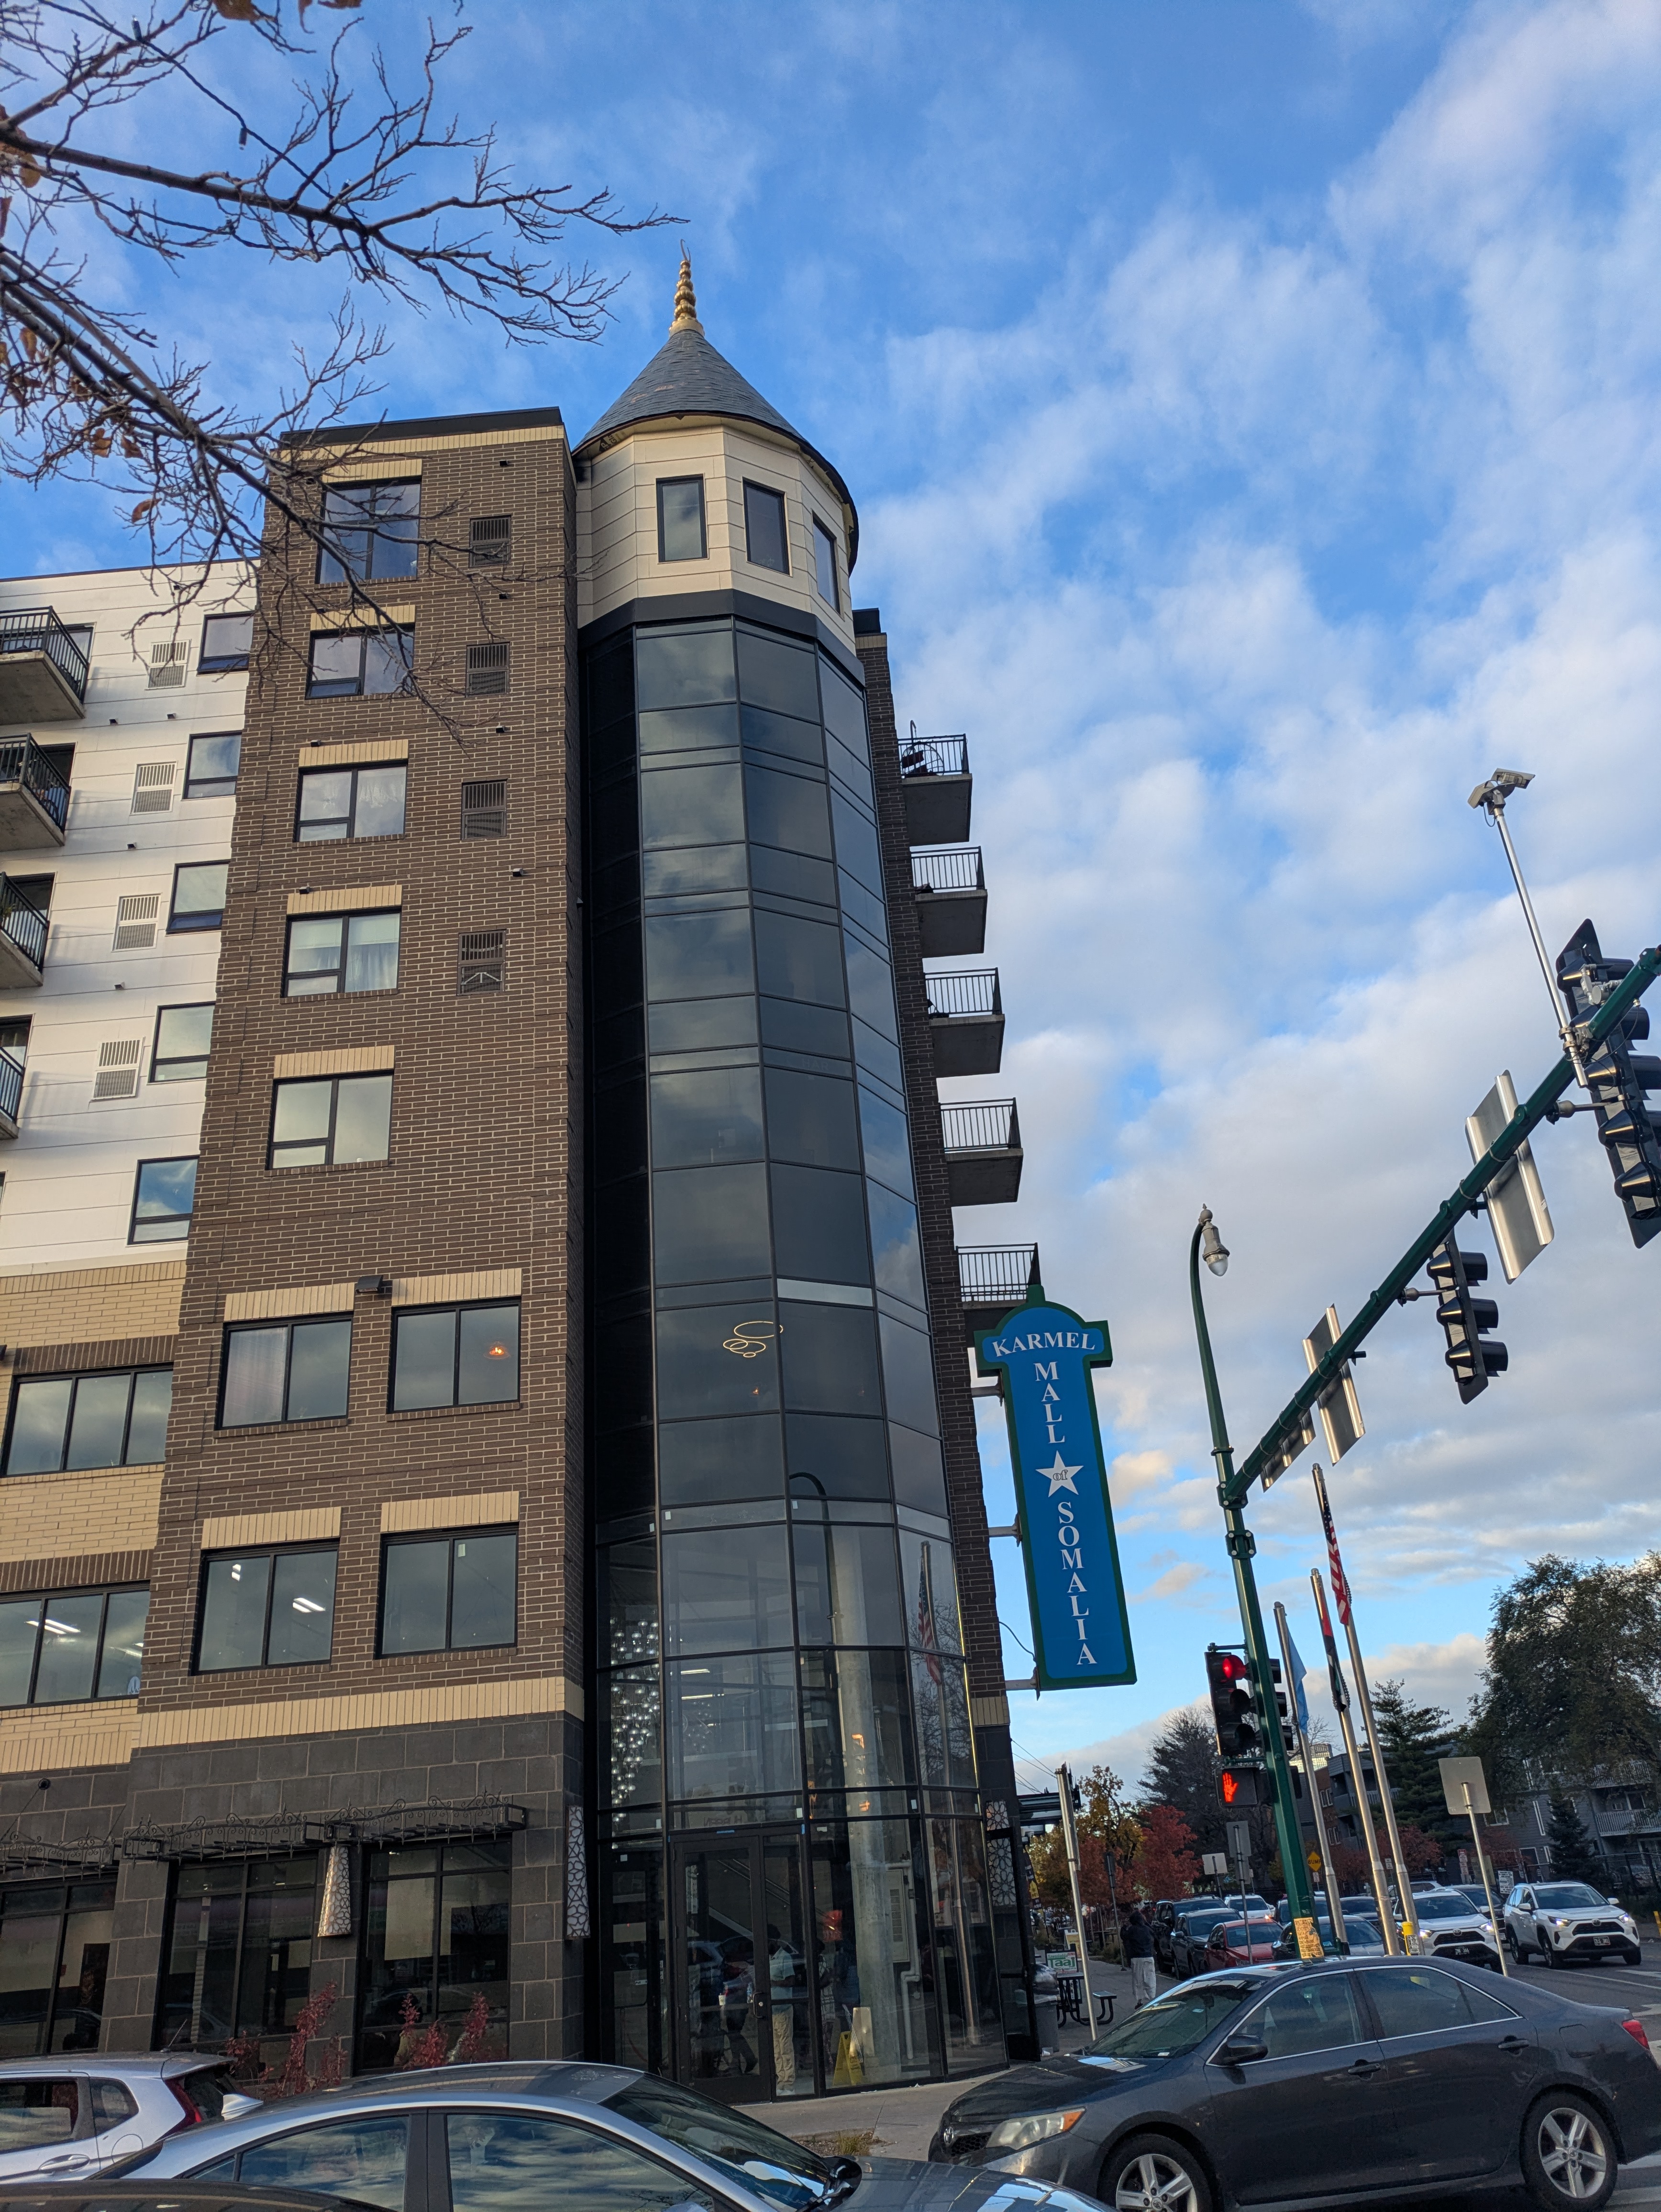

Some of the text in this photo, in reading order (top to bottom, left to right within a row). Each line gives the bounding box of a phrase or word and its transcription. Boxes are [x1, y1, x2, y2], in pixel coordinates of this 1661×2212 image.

[992, 1332, 1096, 1357] KARMEL
[1033, 1361, 1065, 1444] MALL
[1052, 1469, 1068, 1481] of
[1057, 1501, 1097, 1665] SOMALIA
[1048, 1957, 1075, 1968] Taaj
